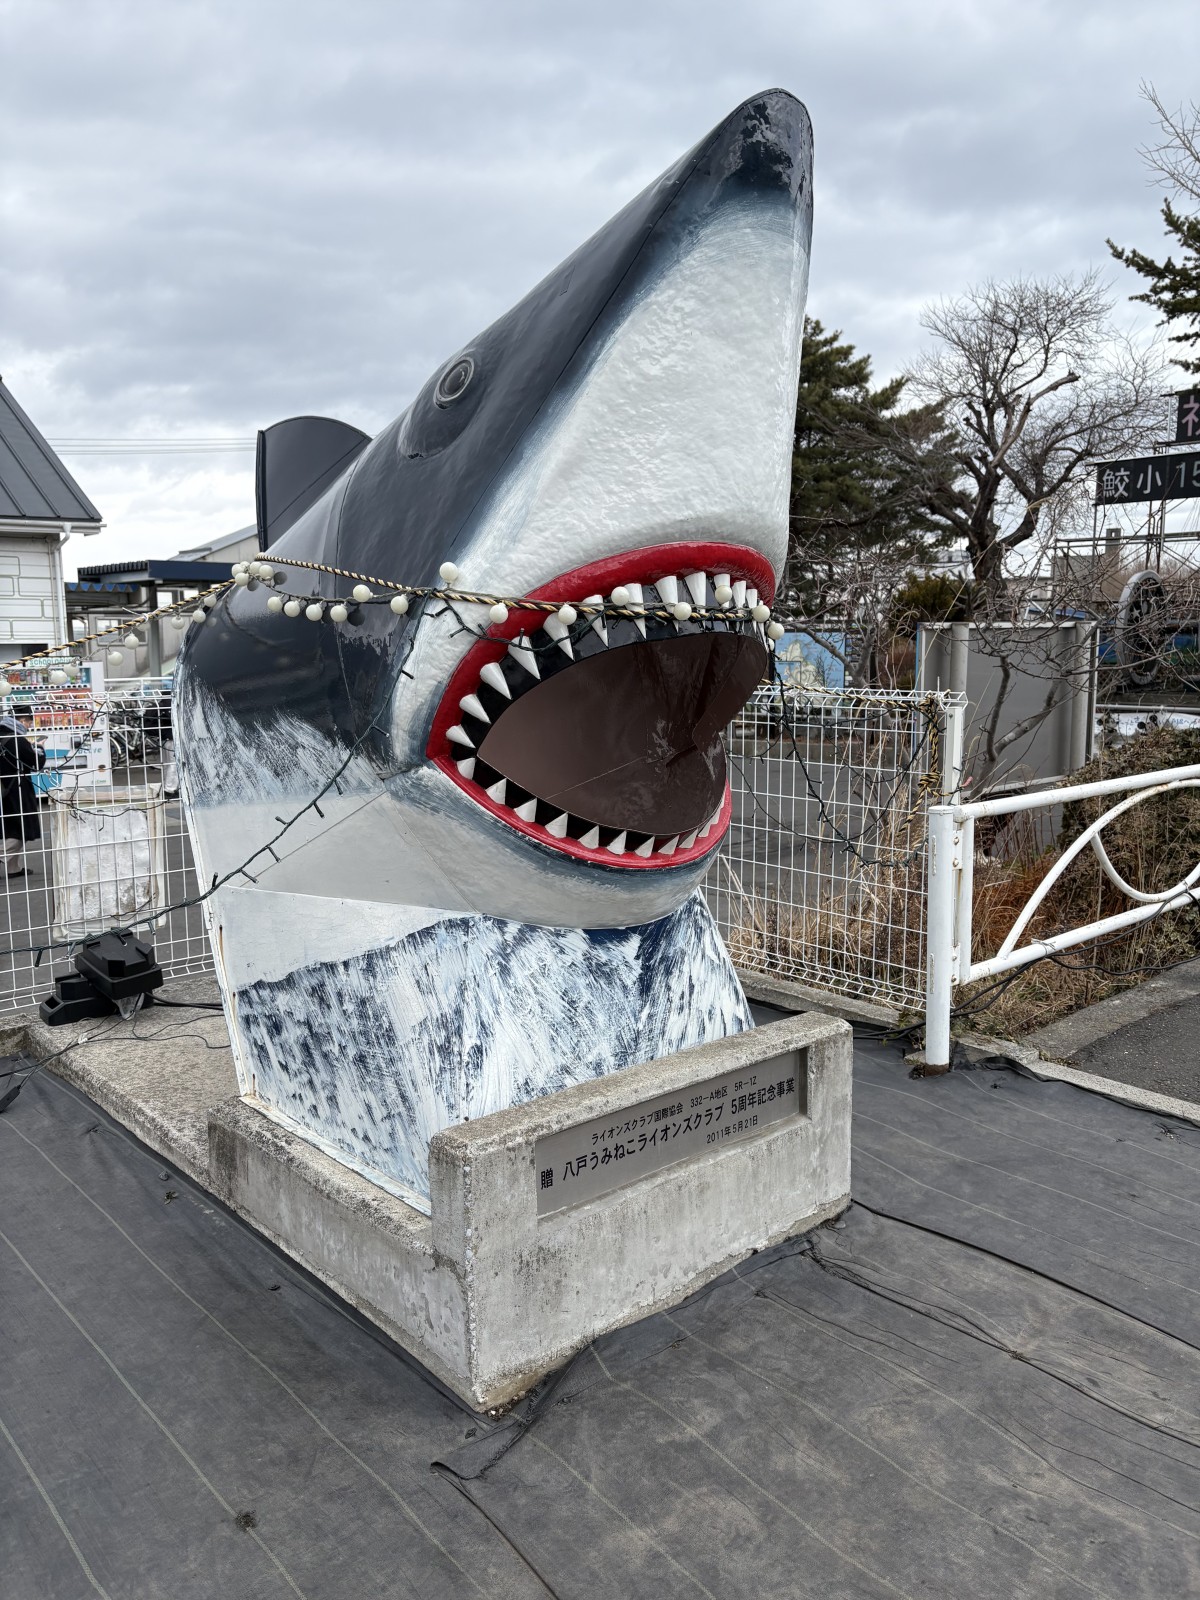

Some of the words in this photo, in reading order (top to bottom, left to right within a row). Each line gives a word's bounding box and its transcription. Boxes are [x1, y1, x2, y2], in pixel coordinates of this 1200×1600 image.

[541, 1168, 554, 1190] 贈
[563, 1102, 725, 1180] 八戸うみねこライオンズクラブ
[731, 1077, 795, 1114] 5周年記念事業
[592, 1102, 683, 1145] ライオンズクラブ国際協会
[706, 1115, 758, 1144] 2011年5月21日
